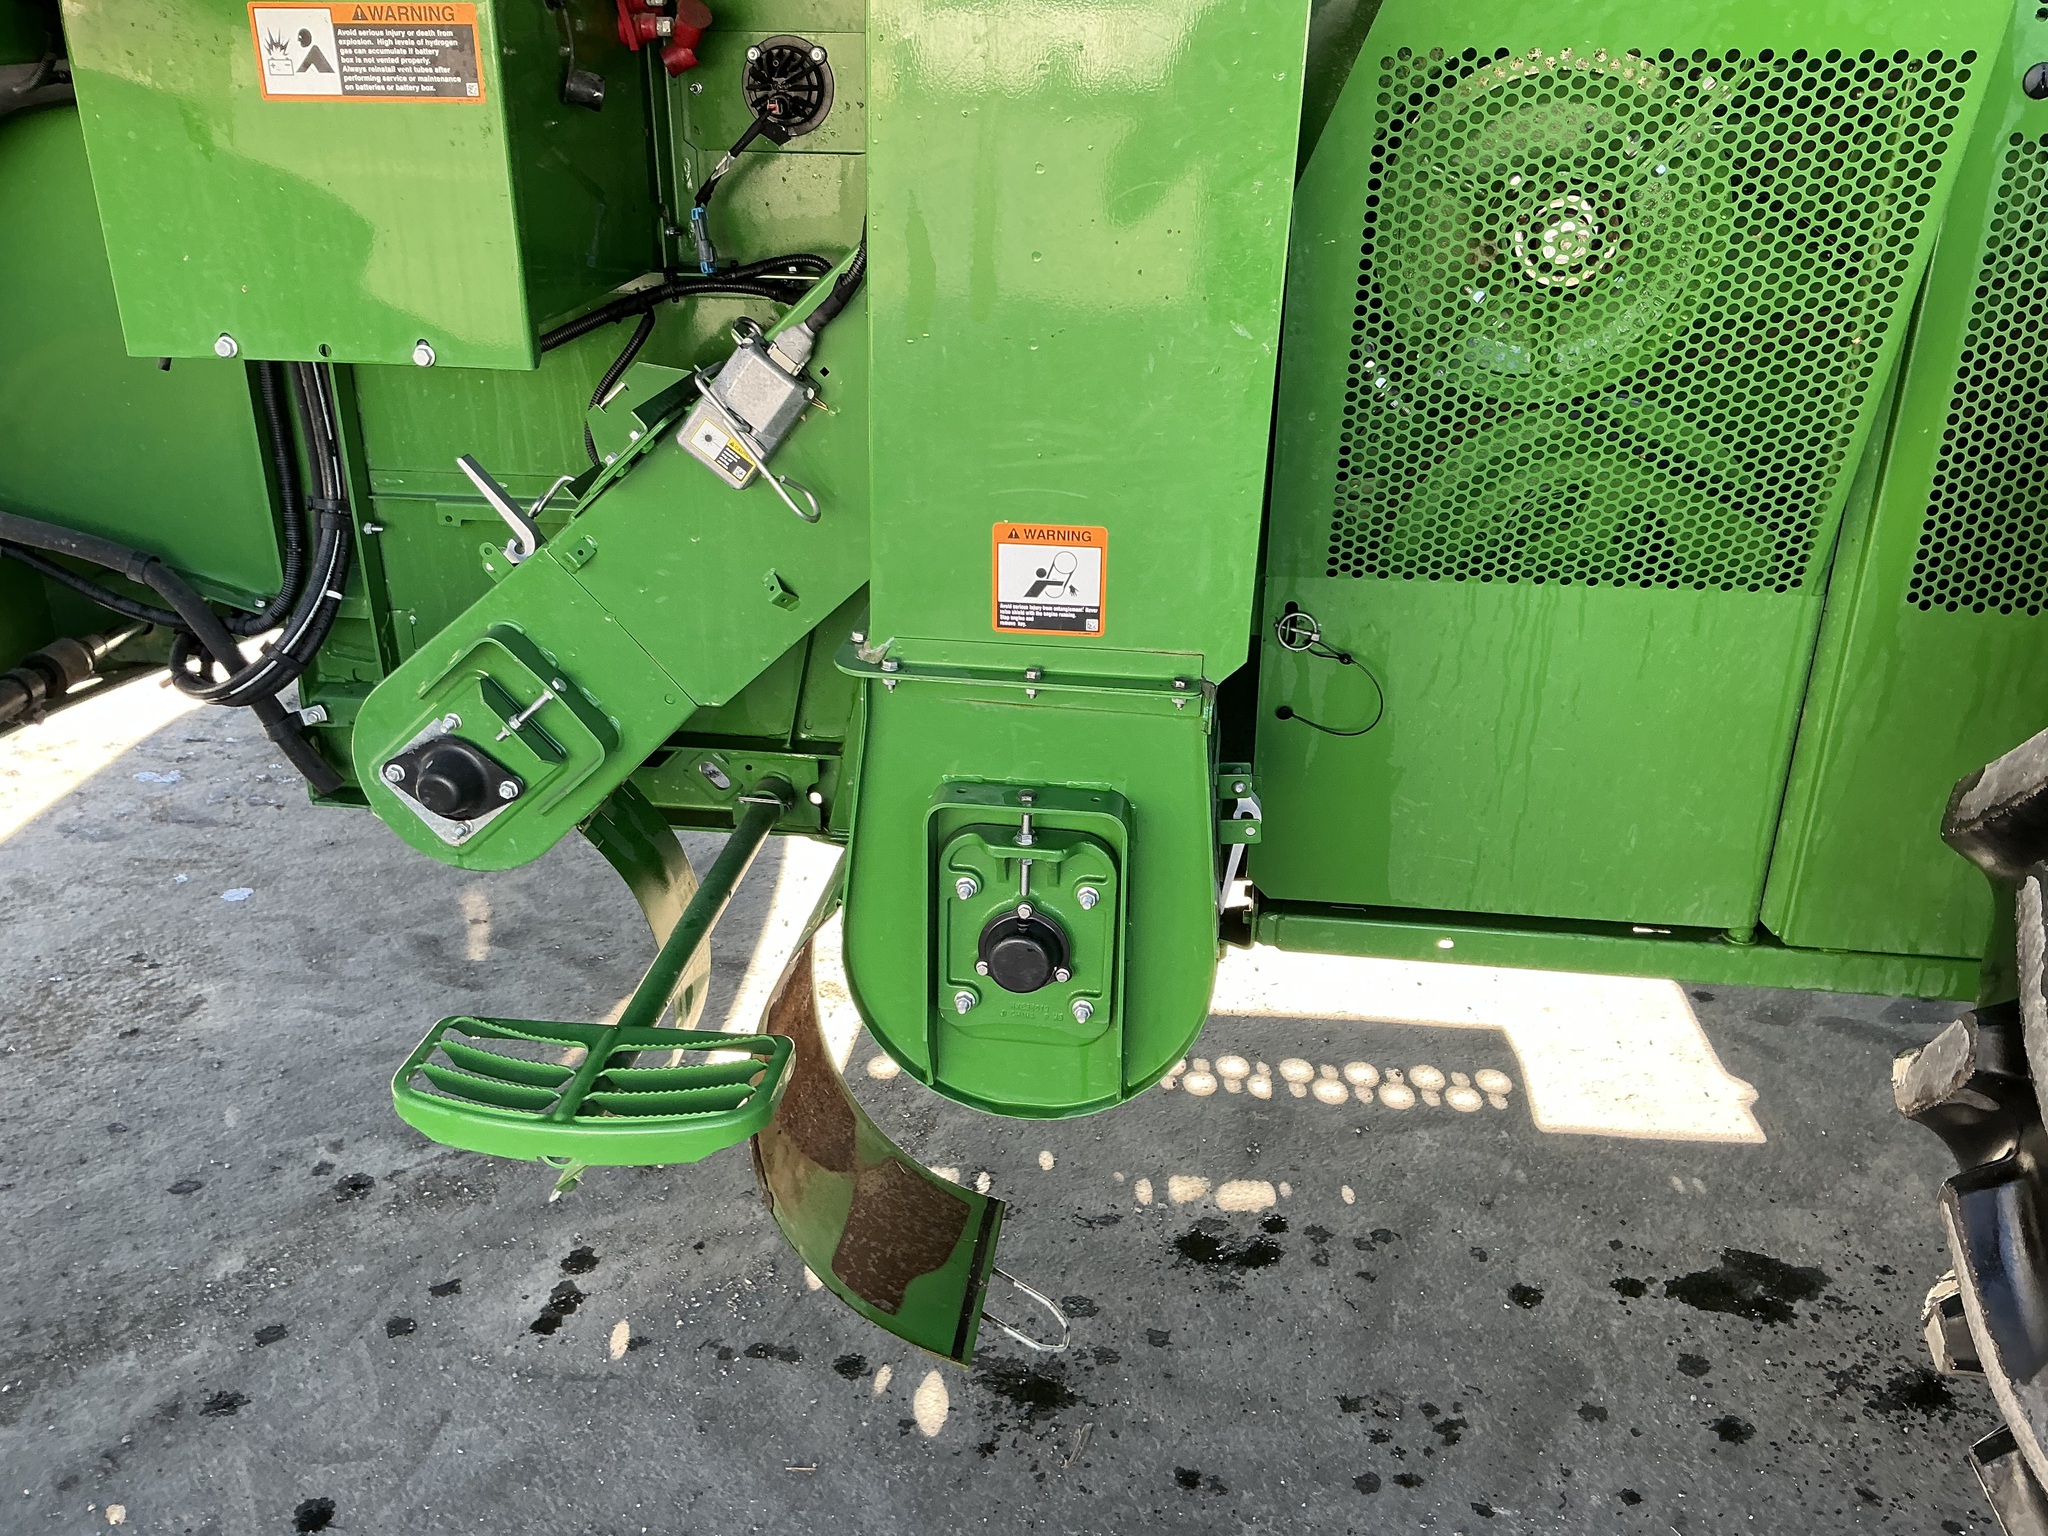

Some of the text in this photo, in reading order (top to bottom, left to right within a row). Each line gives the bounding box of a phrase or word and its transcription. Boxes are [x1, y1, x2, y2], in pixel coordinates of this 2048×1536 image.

[367, 6, 455, 22] WARNING
[385, 29, 405, 37] injury
[425, 39, 458, 47] hydrogen
[735, 446, 753, 462] CAUT
[1024, 529, 1092, 542] WARNING
